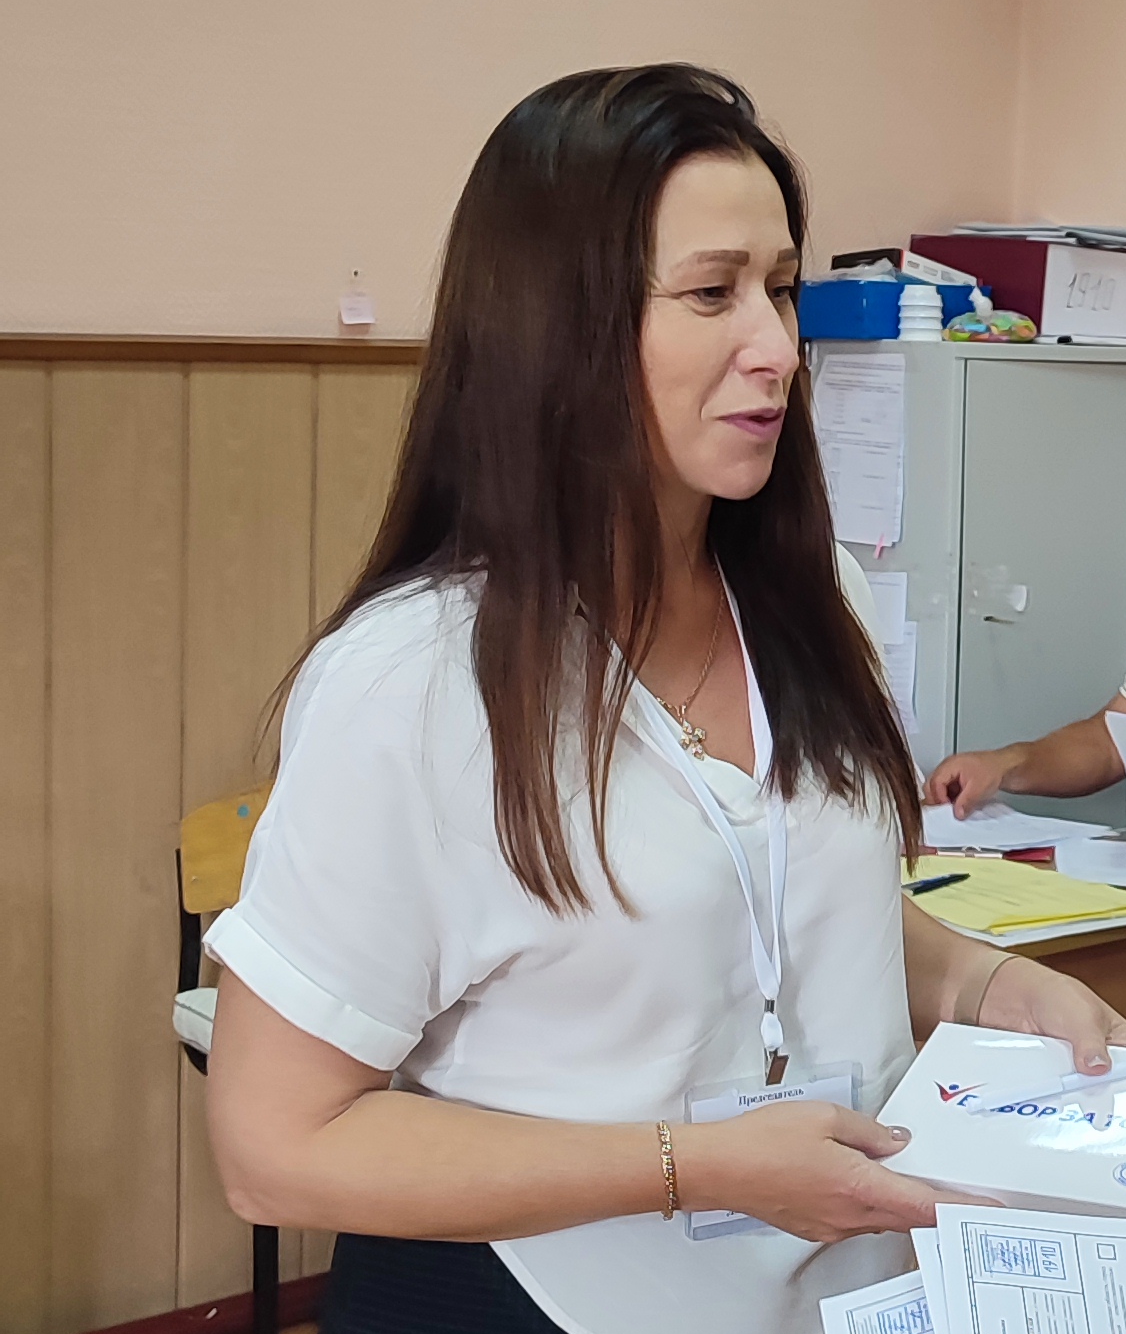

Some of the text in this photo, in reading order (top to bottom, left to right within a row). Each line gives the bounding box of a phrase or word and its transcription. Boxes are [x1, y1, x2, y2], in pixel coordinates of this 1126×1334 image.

[1065, 271, 1117, 313] 1910
[956, 1093, 1058, 1119] БОР
[1040, 1245, 1059, 1274] 1910
